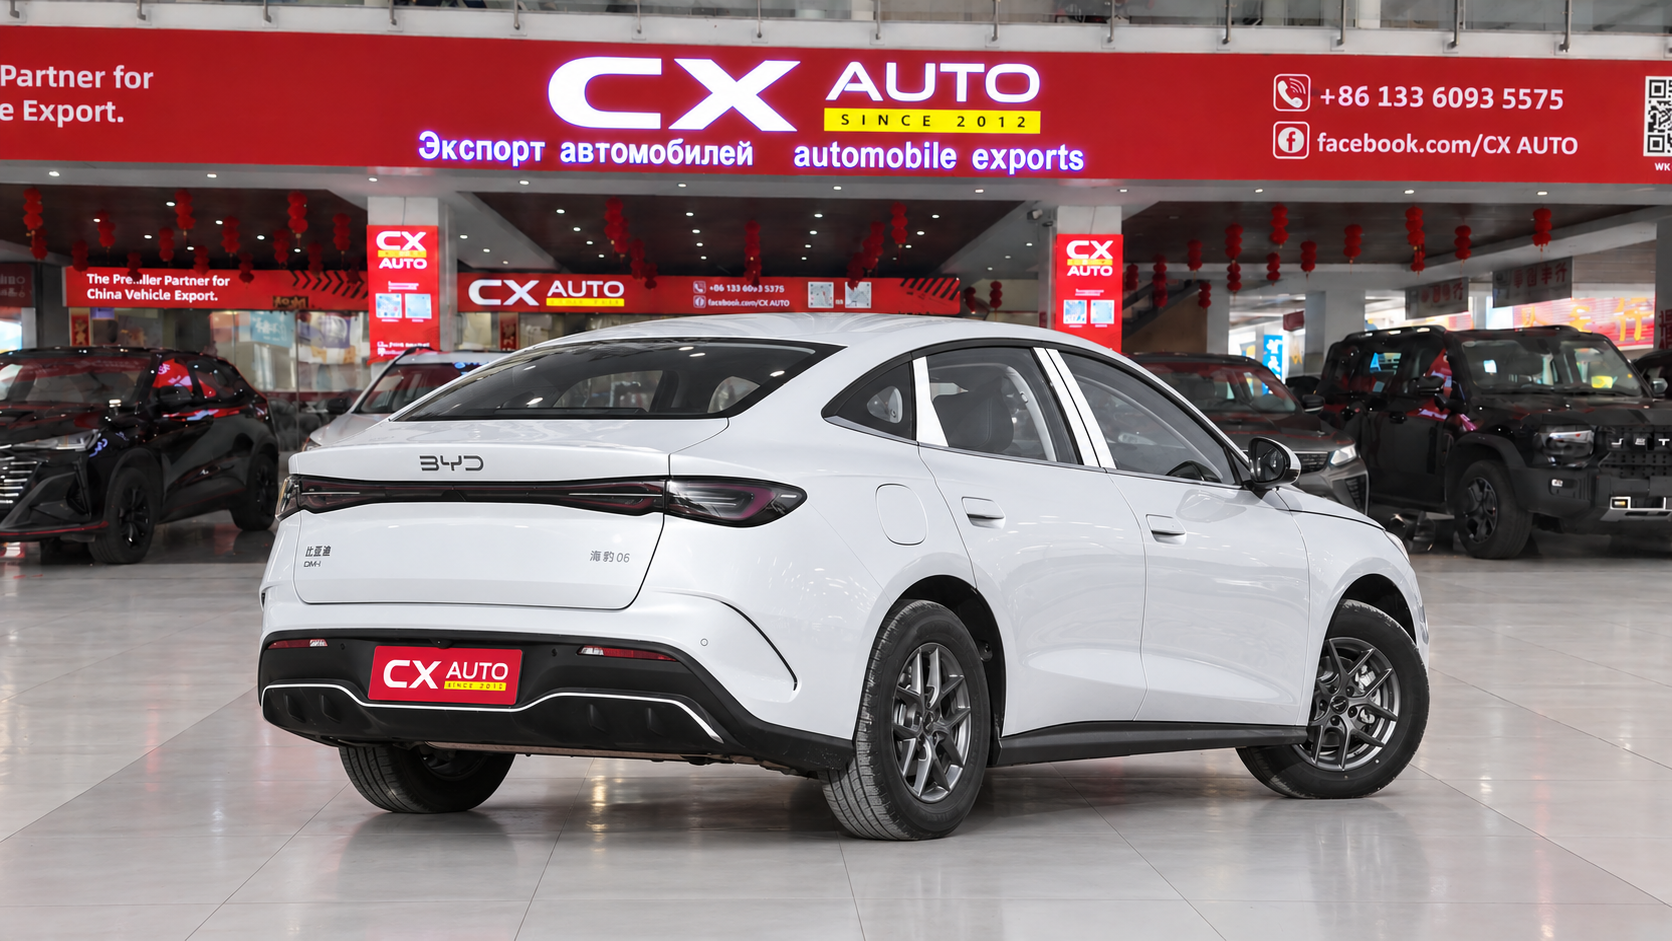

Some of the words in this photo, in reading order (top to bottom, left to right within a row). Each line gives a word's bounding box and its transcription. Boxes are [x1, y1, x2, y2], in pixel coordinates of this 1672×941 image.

[0, 65, 106, 89] Partner
[113, 65, 154, 89] for
[548, 56, 801, 131] CX
[826, 61, 1040, 103] AUTO
[1320, 86, 1370, 107] +86
[1378, 86, 1424, 108] 133
[1432, 87, 1494, 109] 6093
[1502, 87, 1564, 110] 5575
[23, 100, 124, 127] Export.
[841, 113, 931, 127] SINCE
[956, 116, 1027, 128] 2012
[418, 131, 546, 167] Экспорт
[559, 138, 754, 166] автомобилей
[1317, 132, 1511, 157] facebook.com/CX
[1516, 136, 1578, 155] AUTO
[793, 140, 957, 170] automobile
[971, 144, 1085, 175] exports
[376, 230, 427, 251] CX
[1066, 240, 1114, 260] CX
[378, 257, 428, 270] AUTO
[1066, 266, 1113, 277] AUTO
[86, 273, 110, 285] The
[164, 275, 209, 287] Partner
[211, 275, 230, 287] for
[86, 288, 122, 300] China
[125, 289, 171, 301] Vehicle
[174, 290, 218, 303] Export.
[468, 279, 540, 306] CX
[546, 280, 625, 298] AUTO
[769, 299, 790, 307] AUTO
[419, 455, 484, 472] BYD
[383, 659, 442, 690] CX
[445, 661, 509, 681] AUTO
[447, 682, 473, 690] SINCE
